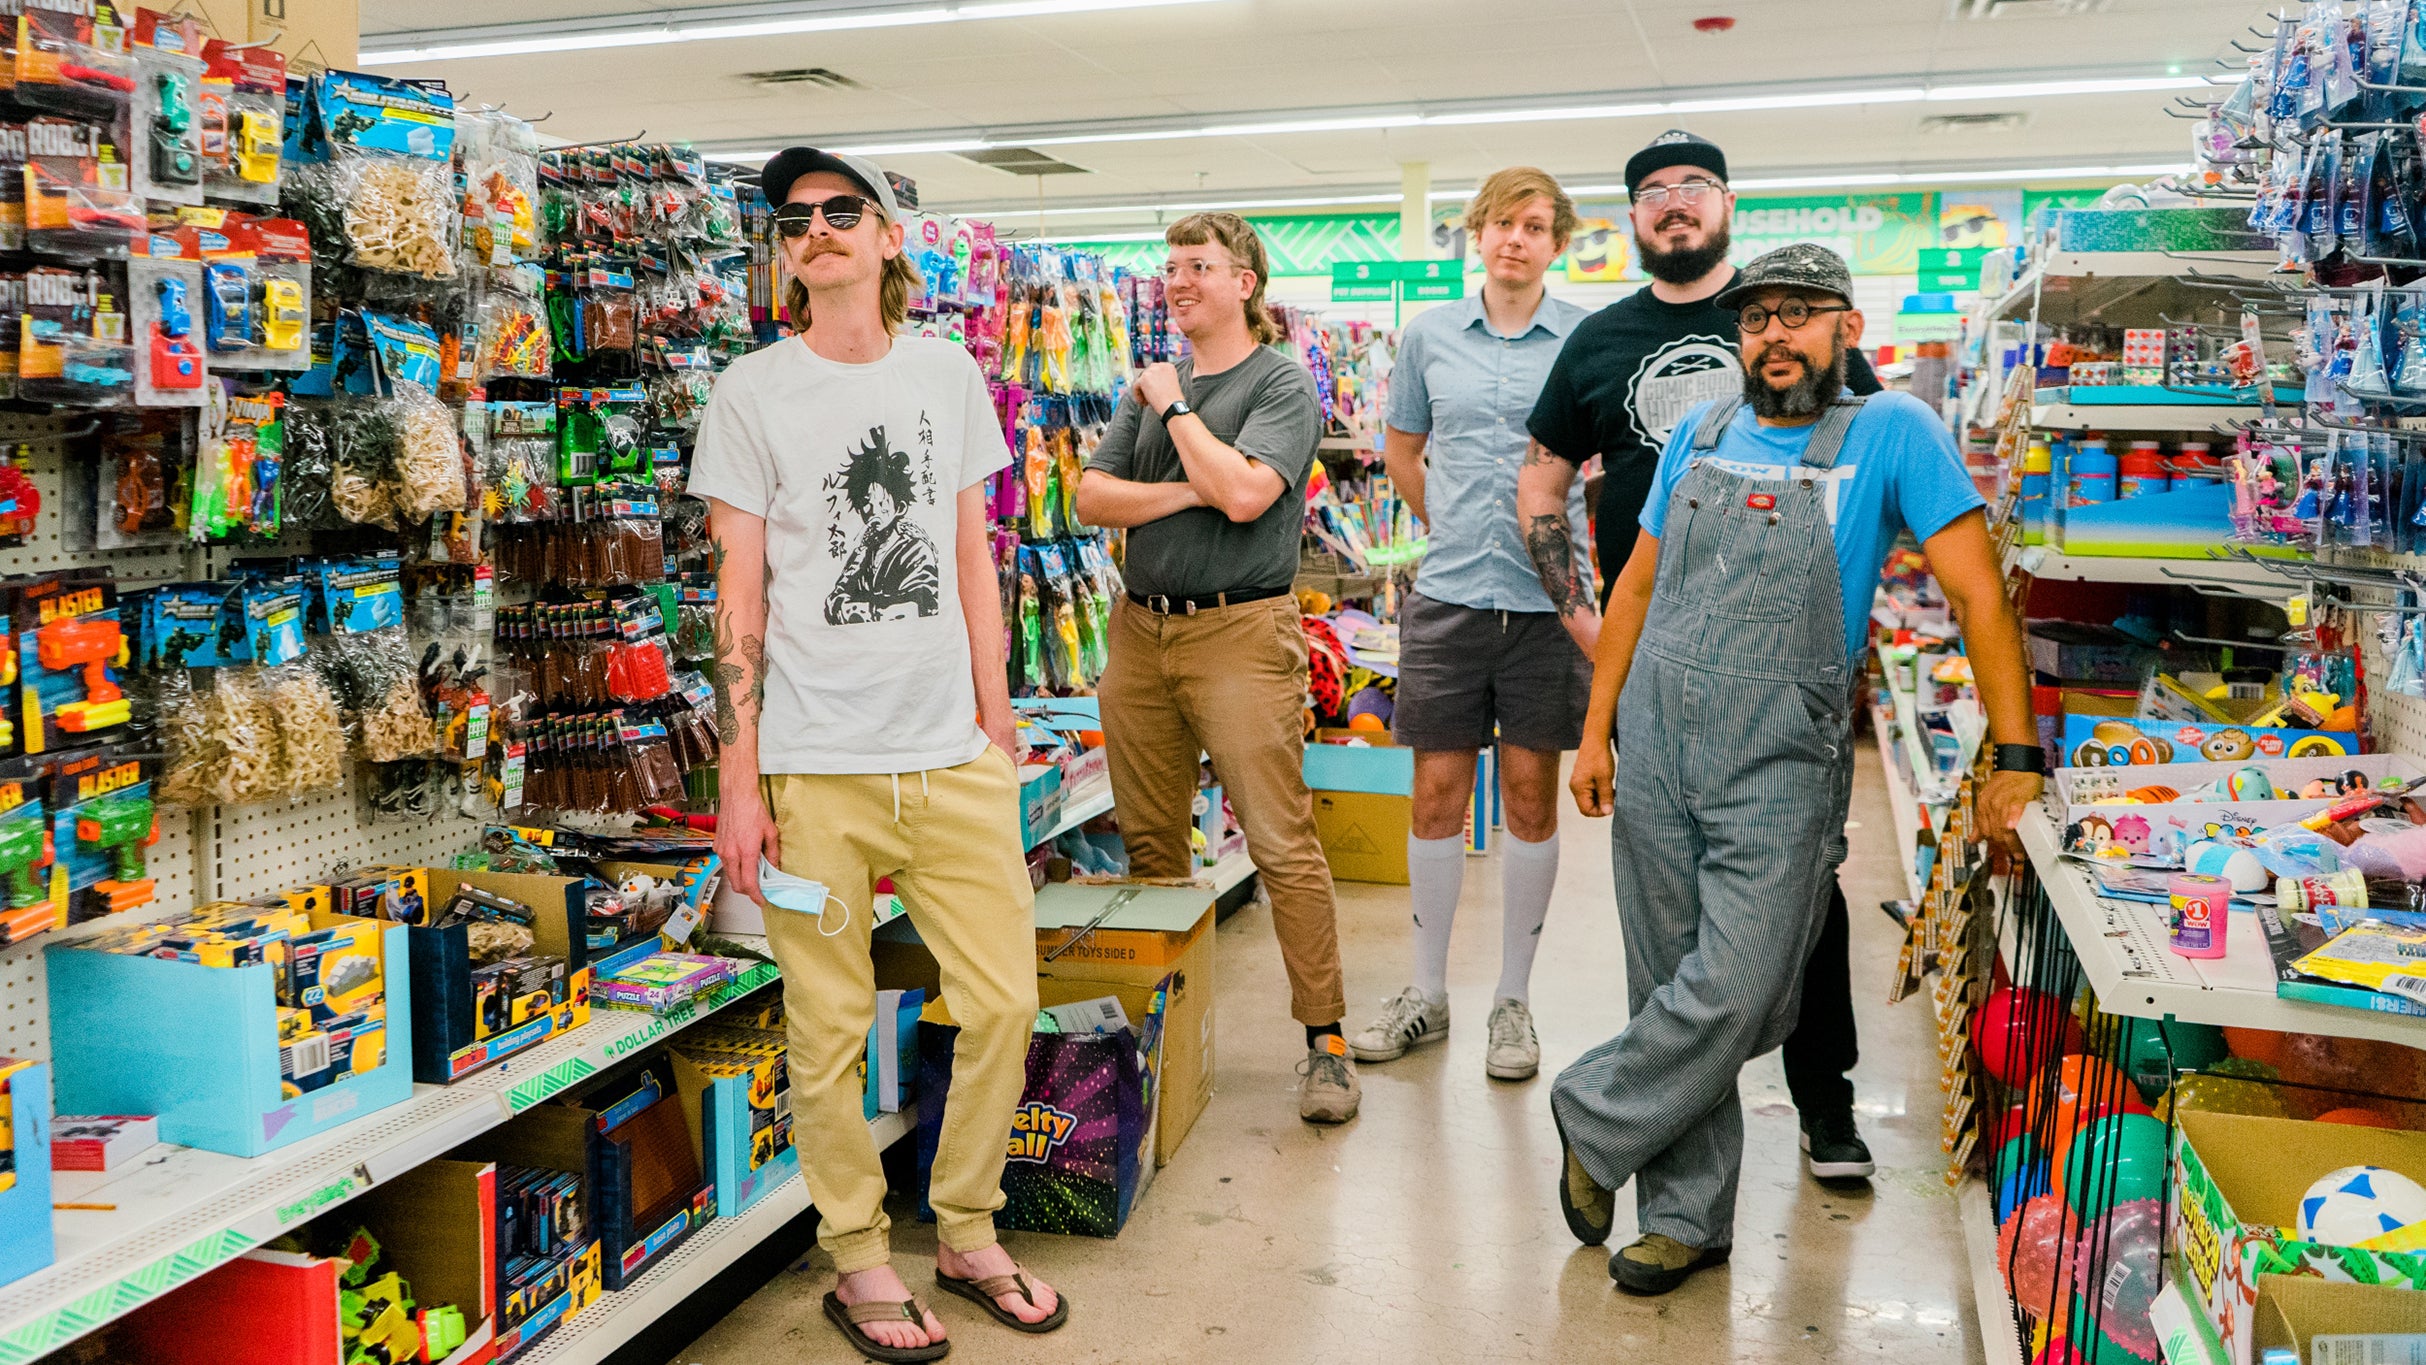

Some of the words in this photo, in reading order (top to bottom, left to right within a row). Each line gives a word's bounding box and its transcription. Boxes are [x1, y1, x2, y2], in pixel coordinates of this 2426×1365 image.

[1731, 207, 1883, 236] USEHOLD
[1356, 264, 1369, 279] 3
[1425, 263, 1440, 278] 2
[229, 397, 271, 426] NINJA
[78, 761, 141, 801] BLASTER
[1077, 946, 1102, 957] TOYS
[1104, 947, 1126, 959] SIDE
[1128, 949, 1136, 959] D
[700, 972, 722, 988] PUZZLE
[616, 991, 642, 1002] PUZZLE
[649, 991, 660, 999] 24
[614, 1020, 665, 1055] DOLLAR
[666, 1004, 697, 1028] TREE
[1013, 1107, 1071, 1140] elty
[1007, 1132, 1048, 1158] all
